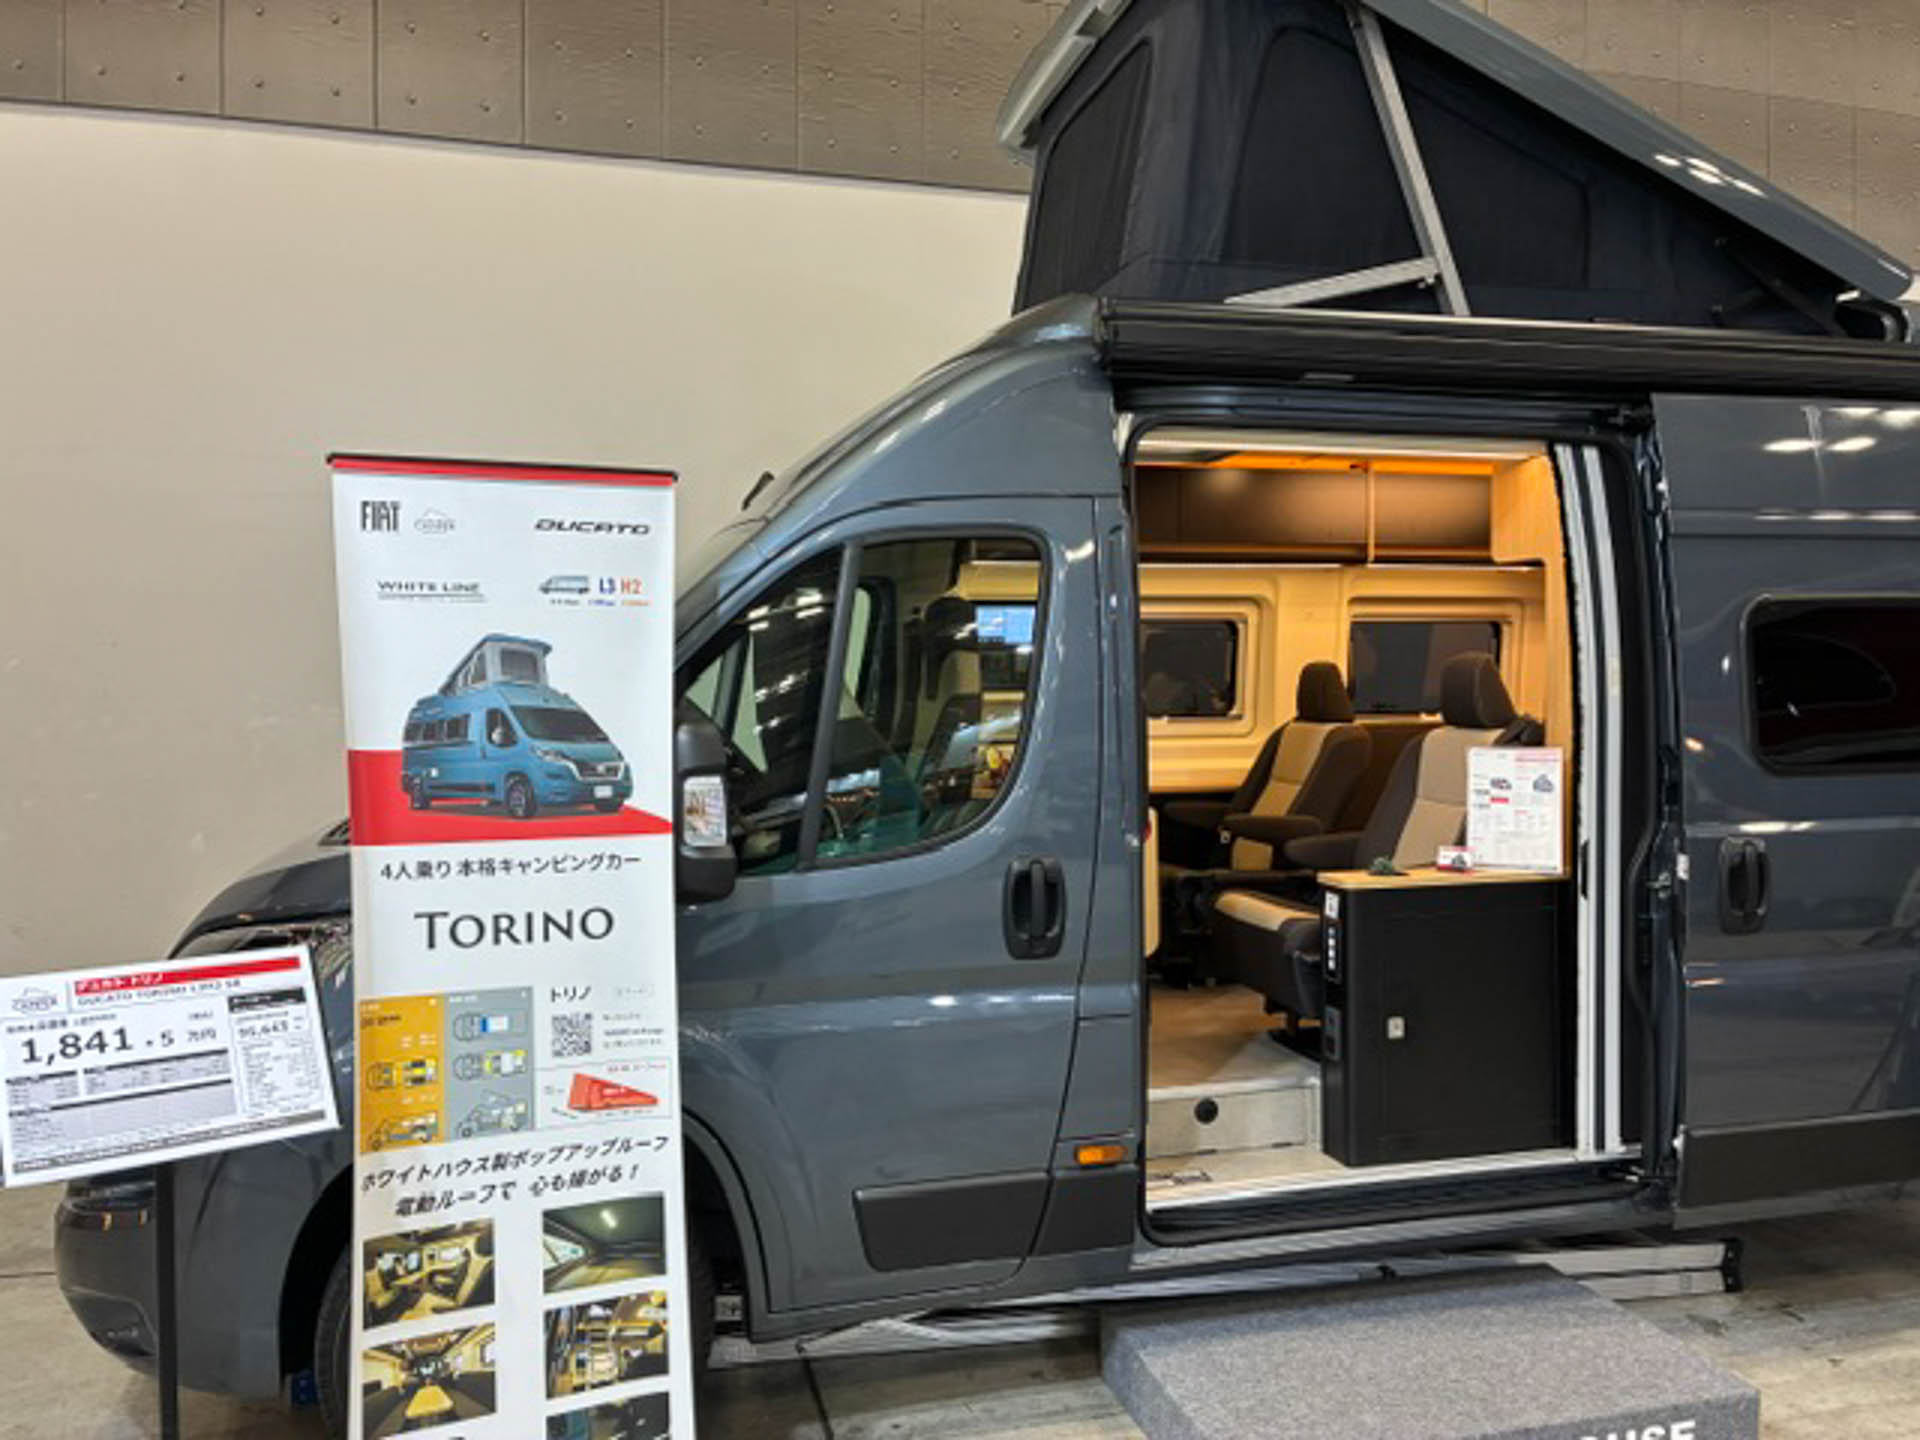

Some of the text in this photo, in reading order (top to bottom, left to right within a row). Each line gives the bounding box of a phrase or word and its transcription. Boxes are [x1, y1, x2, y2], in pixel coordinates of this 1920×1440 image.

[361, 501, 400, 531] FIAT
[534, 518, 650, 535] DUCATO
[377, 581, 480, 593] WHITE LINE
[599, 577, 642, 595] L3 H2
[457, 853, 641, 878] 本格キャンピングカー
[413, 907, 614, 950] TORINO
[550, 985, 592, 1003] トリノ
